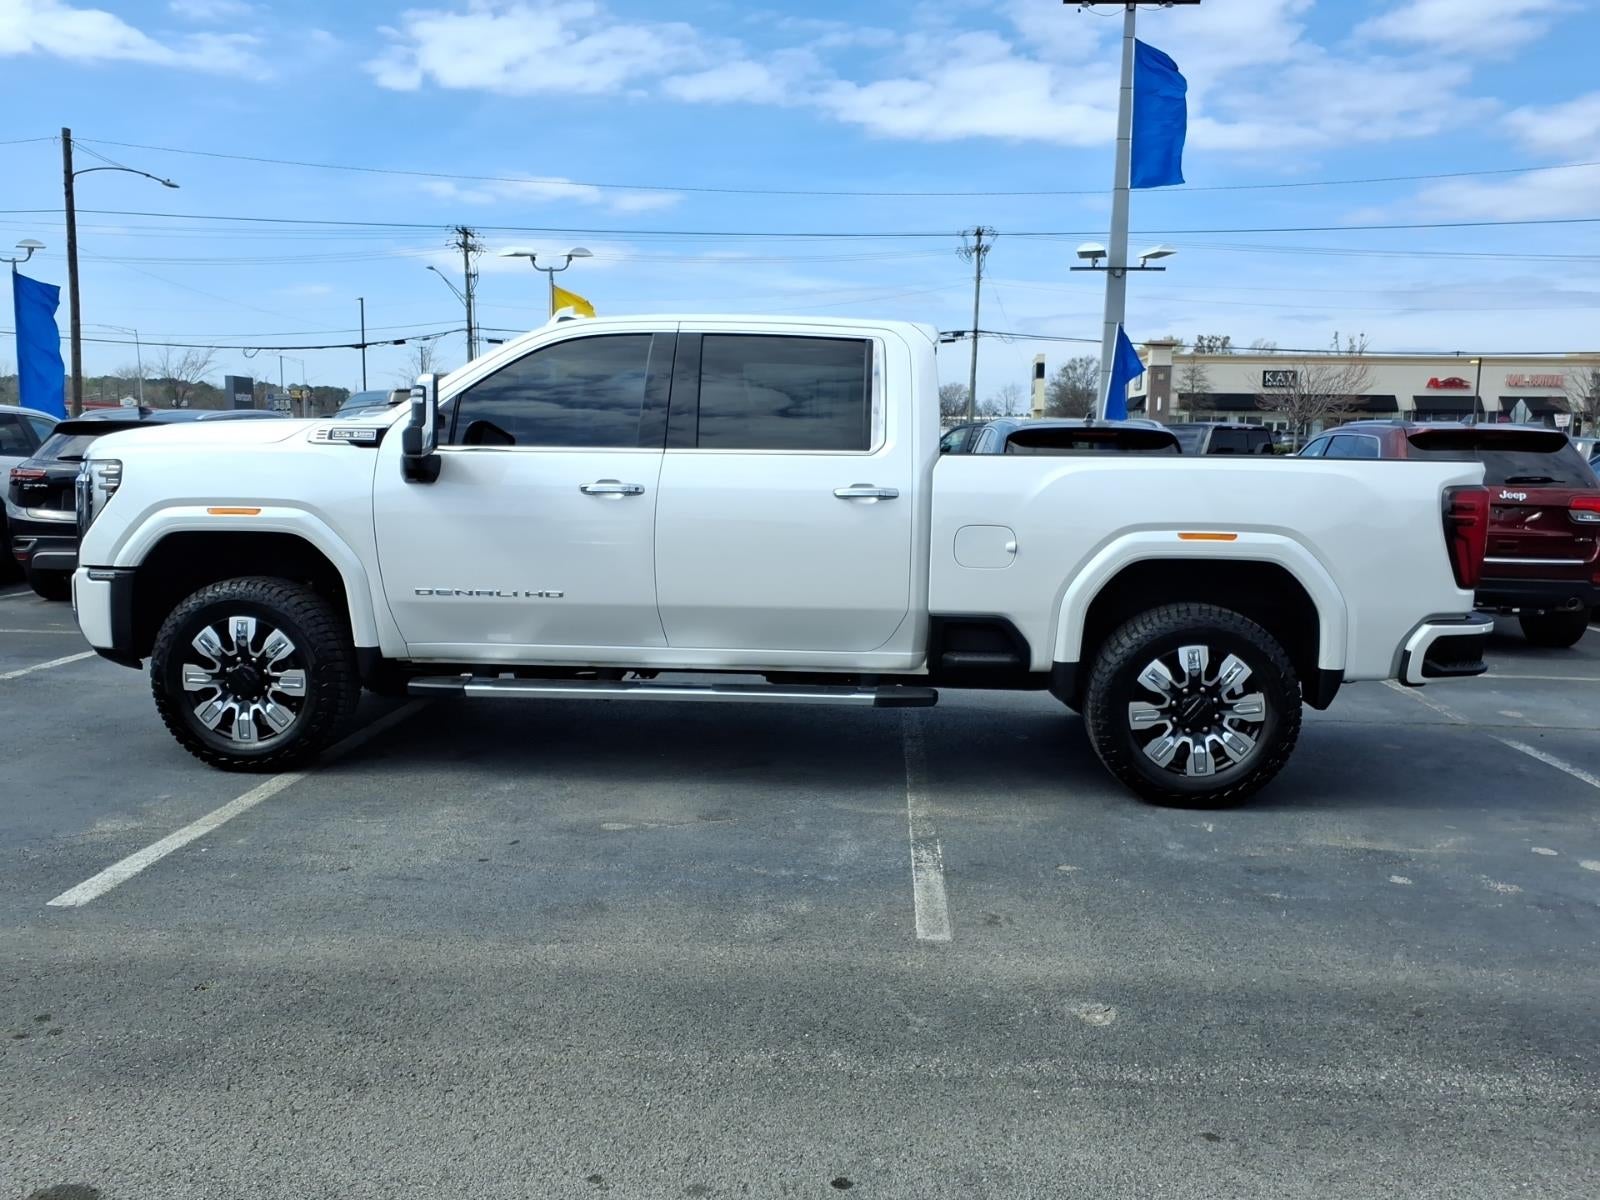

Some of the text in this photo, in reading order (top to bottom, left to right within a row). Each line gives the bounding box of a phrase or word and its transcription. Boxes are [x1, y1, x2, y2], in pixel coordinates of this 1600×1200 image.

[1265, 372, 1293, 382] KAY
[1499, 490, 1527, 501] Jeep
[415, 588, 564, 598] DENALI HD
